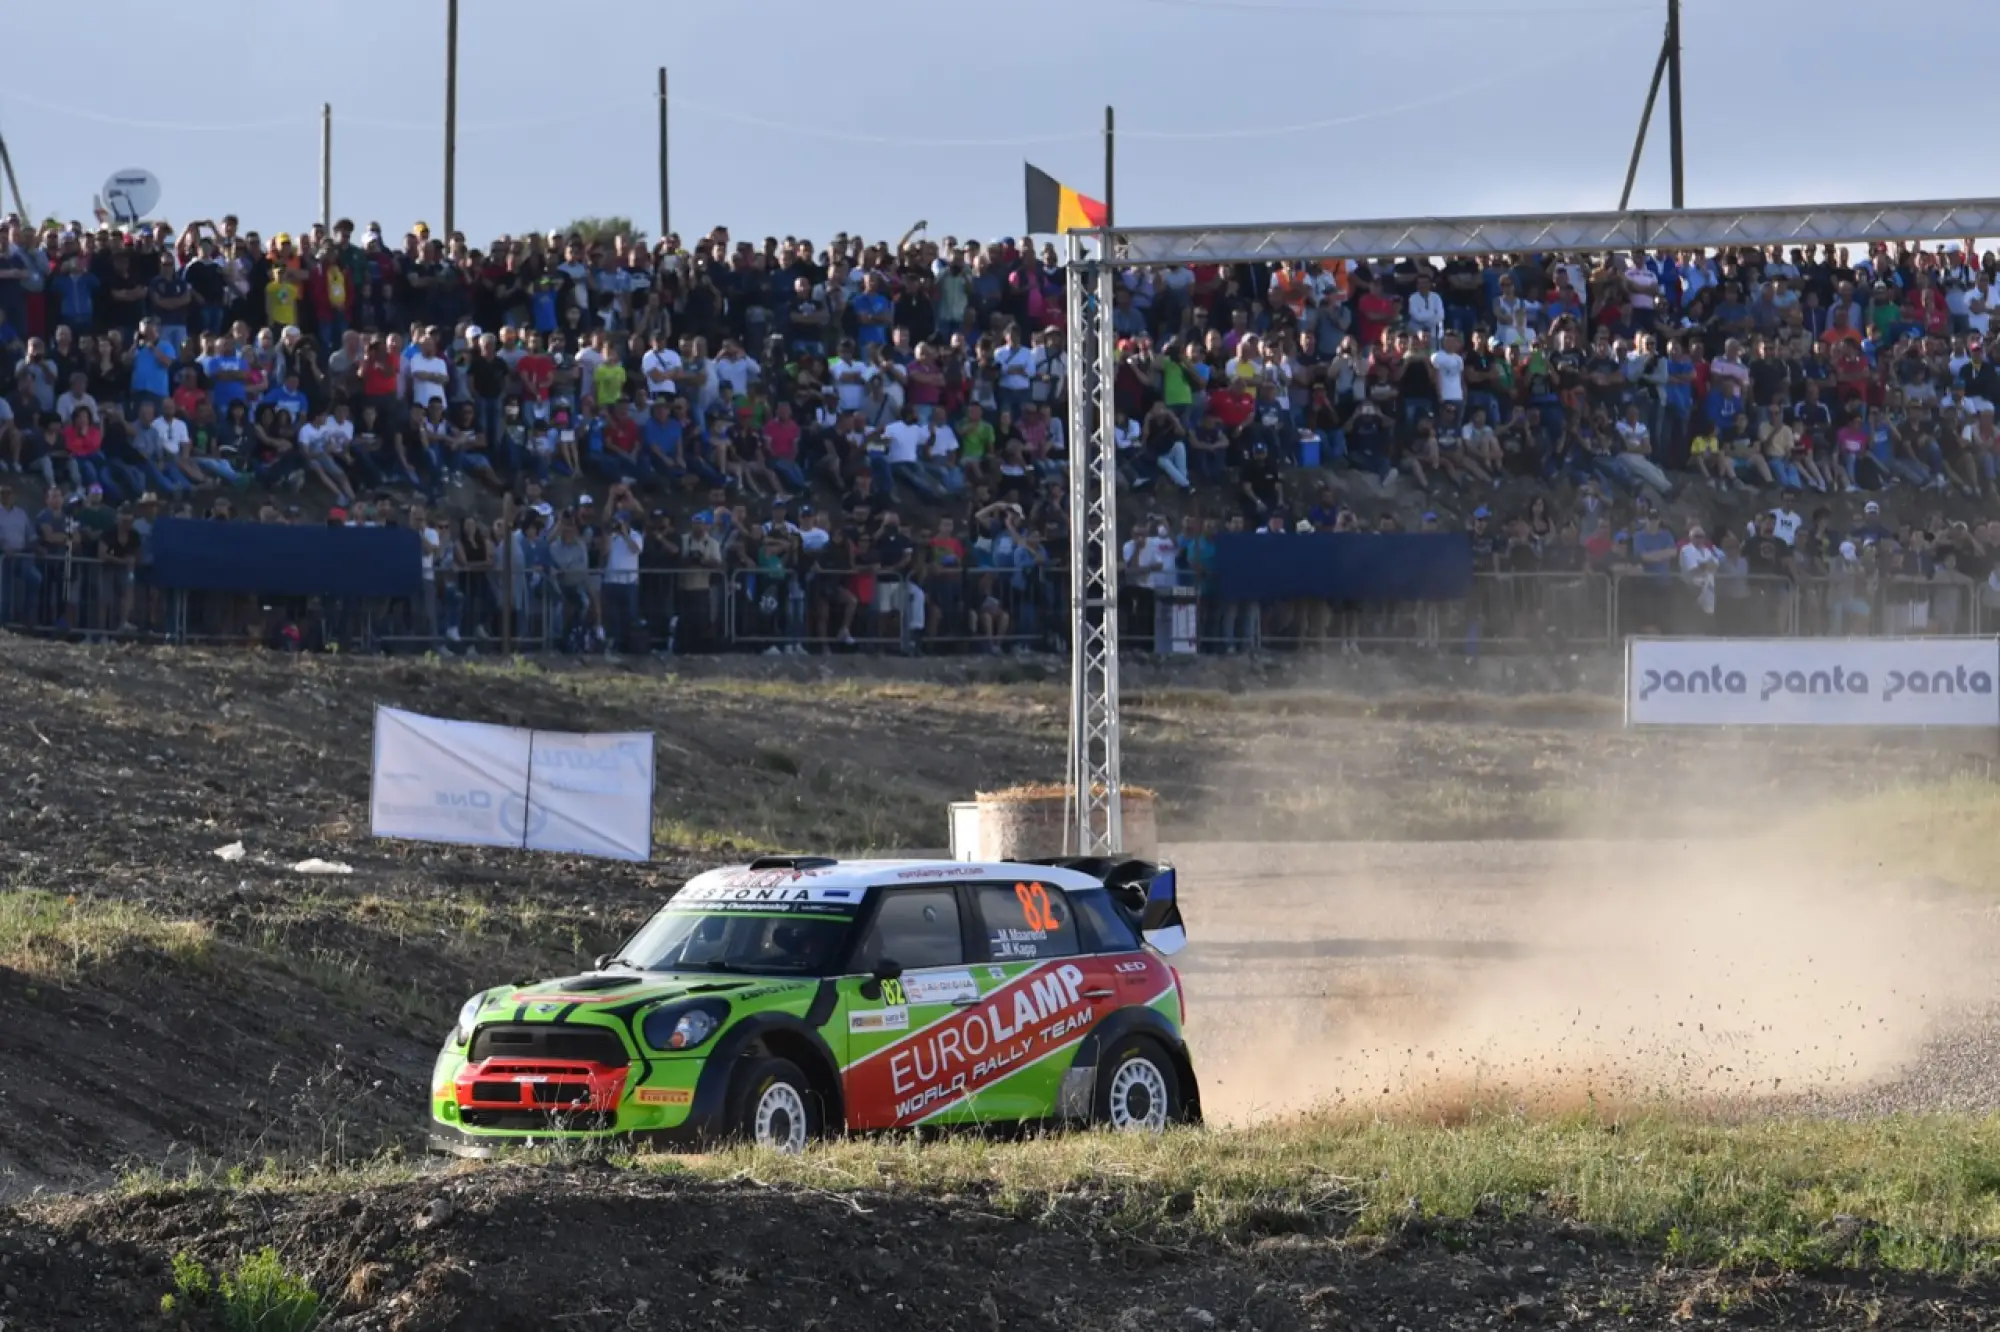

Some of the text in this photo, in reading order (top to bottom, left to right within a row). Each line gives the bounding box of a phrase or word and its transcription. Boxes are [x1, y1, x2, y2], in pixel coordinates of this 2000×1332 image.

[1639, 664, 1992, 702] panta panta panta
[1015, 881, 1060, 932] 82
[1114, 961, 1147, 974] LED
[881, 978, 905, 1005] 82
[890, 964, 1084, 1095] EUROLAMP
[895, 1007, 1093, 1119] WORLD RALLY TEAM
